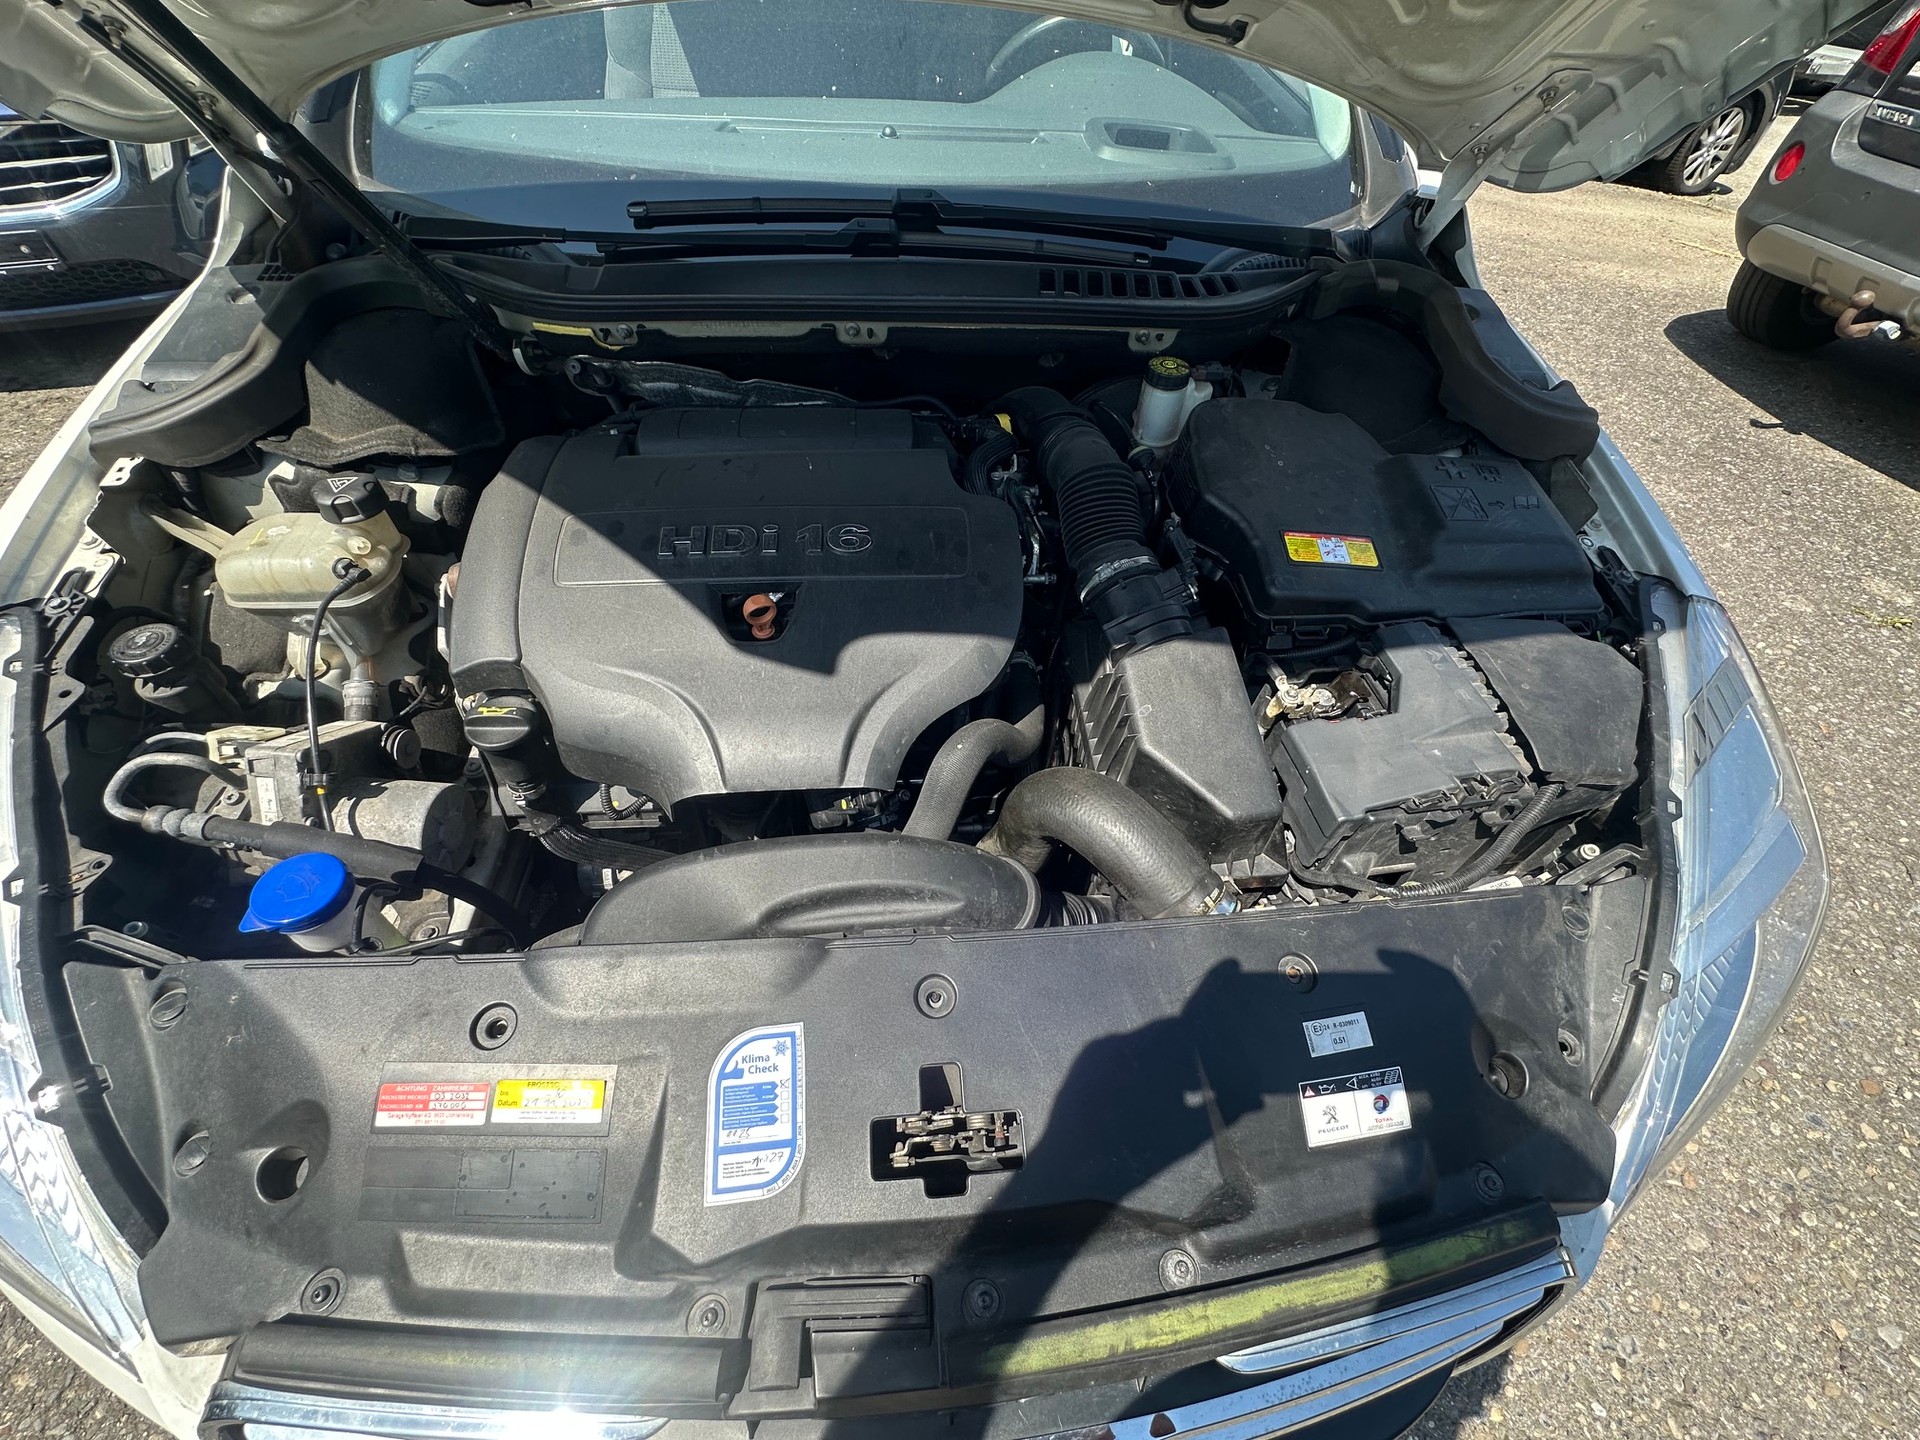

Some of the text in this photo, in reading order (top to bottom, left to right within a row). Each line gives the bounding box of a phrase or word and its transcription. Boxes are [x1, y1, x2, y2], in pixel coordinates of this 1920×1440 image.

[657, 523, 873, 558] HDi 16
[1333, 1036, 1347, 1045] 0.51
[741, 1054, 771, 1065] Klima
[748, 1063, 779, 1075] Check
[1318, 1125, 1350, 1134] PEUGEOT
